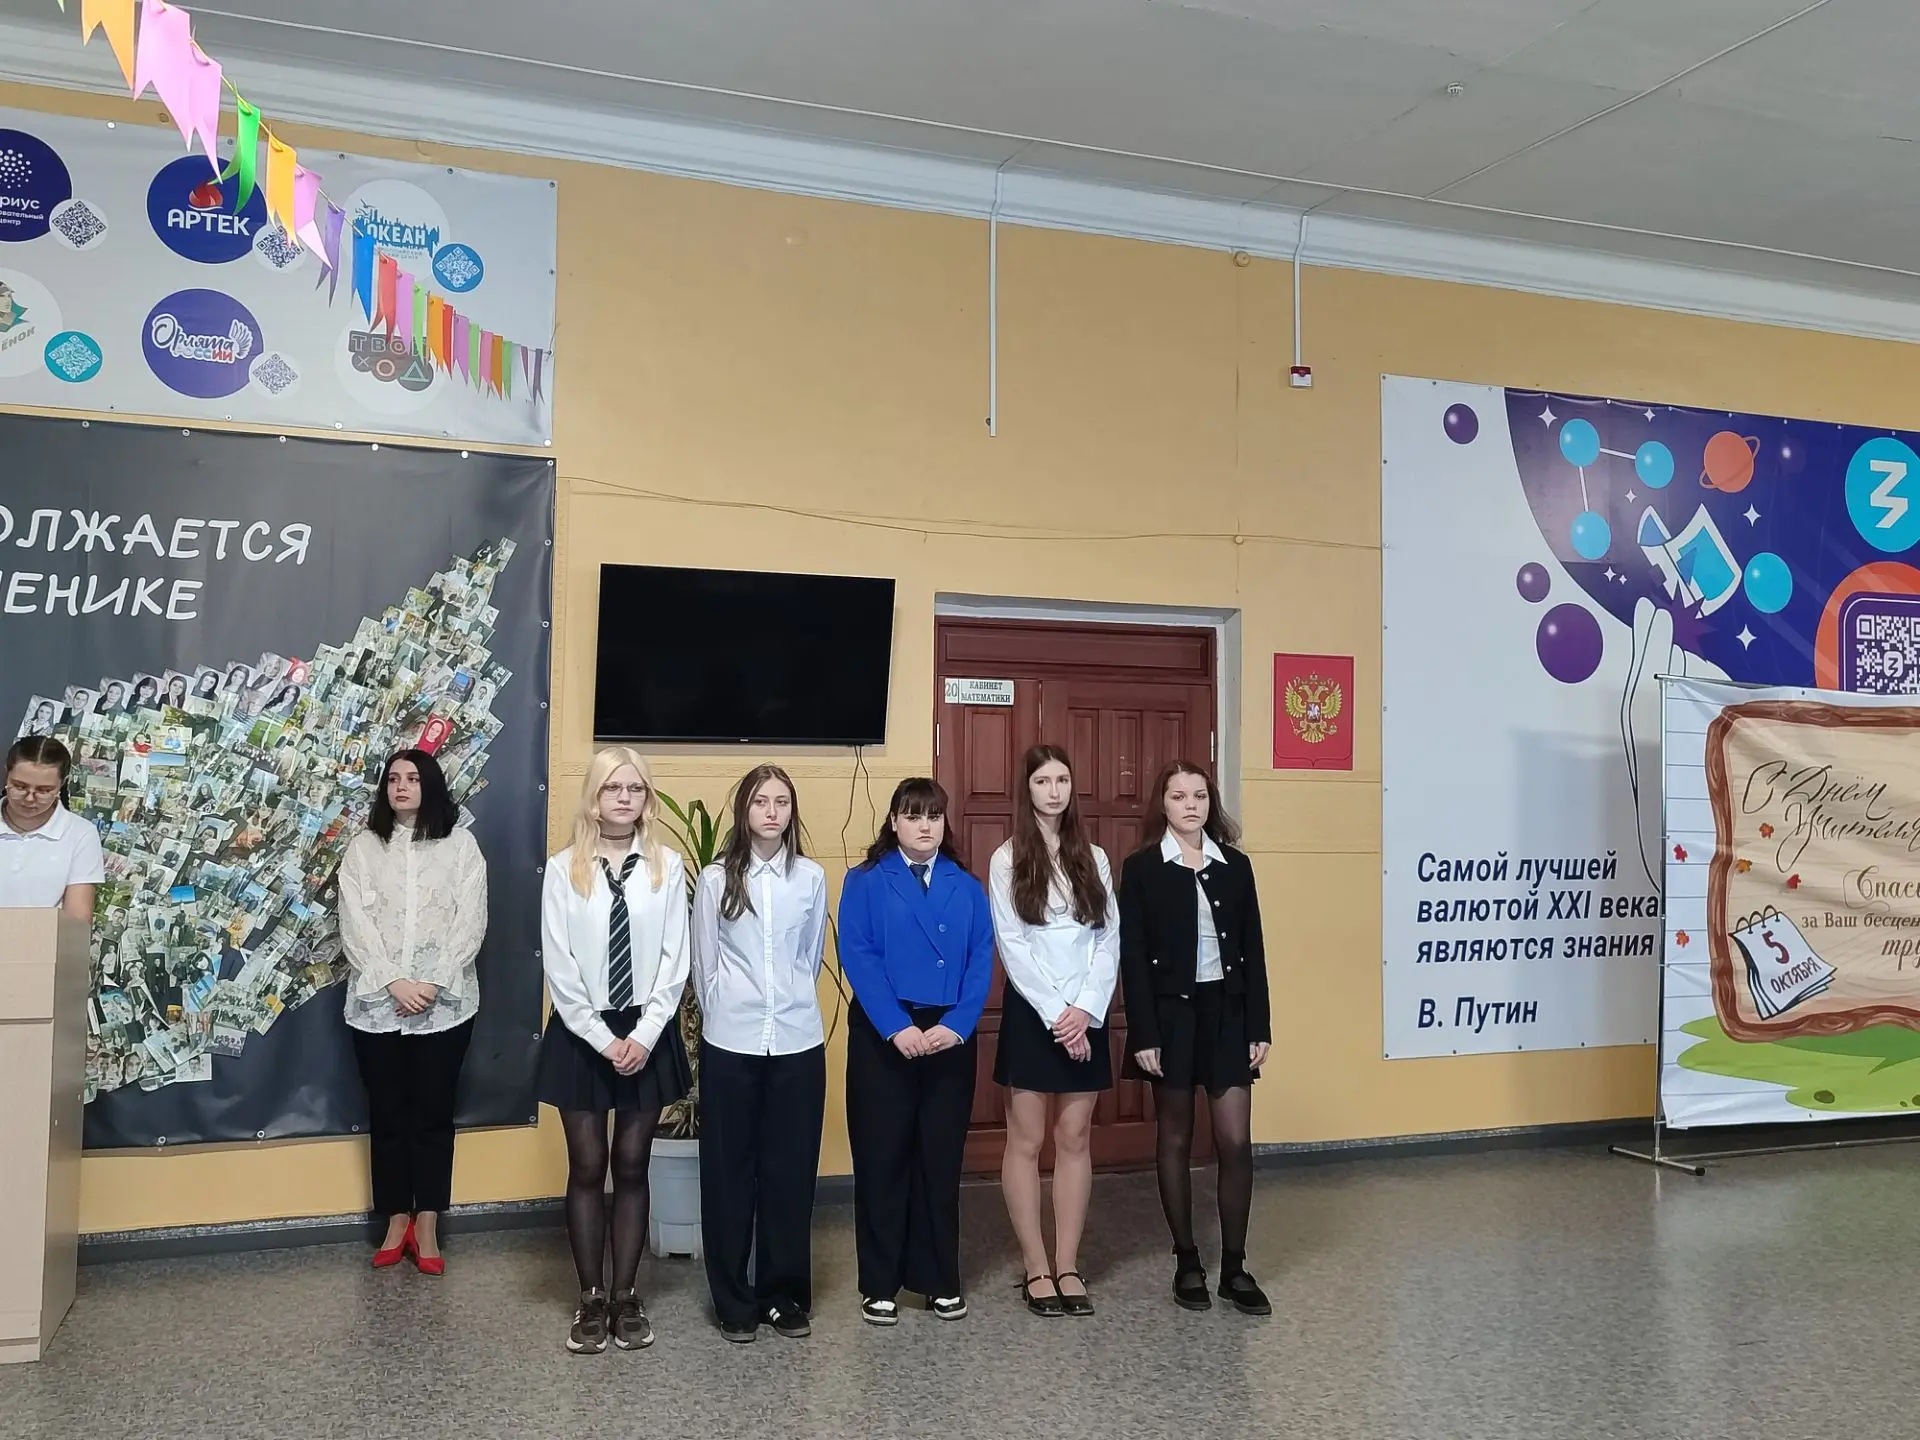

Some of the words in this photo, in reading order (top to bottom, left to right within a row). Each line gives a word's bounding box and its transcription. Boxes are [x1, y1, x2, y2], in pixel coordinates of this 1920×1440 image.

[167, 208, 250, 236] АРТЕК
[366, 223, 426, 245] ОКЕАН
[152, 315, 234, 352] Орлята
[0, 570, 204, 620] ЕНИКЕ
[945, 683, 958, 698] 20
[960, 692, 1011, 703] МАТЕМАТИКИ
[969, 681, 1003, 691] КАБИНЕТ
[1417, 851, 1508, 882] Самой
[1515, 850, 1618, 889] лучшей
[1416, 890, 1540, 923] валютой
[1546, 890, 1592, 920] XXI
[1599, 894, 1659, 919] века
[1801, 916, 1819, 929] за
[1824, 911, 1858, 929] Ваш
[1416, 936, 1553, 964] являются
[1563, 933, 1655, 959] знания
[1761, 930, 1790, 964] 5
[1770, 956, 1823, 994] ОКТЯБРЯ
[1417, 998, 1444, 1029] В.
[1454, 996, 1538, 1034] Путин
